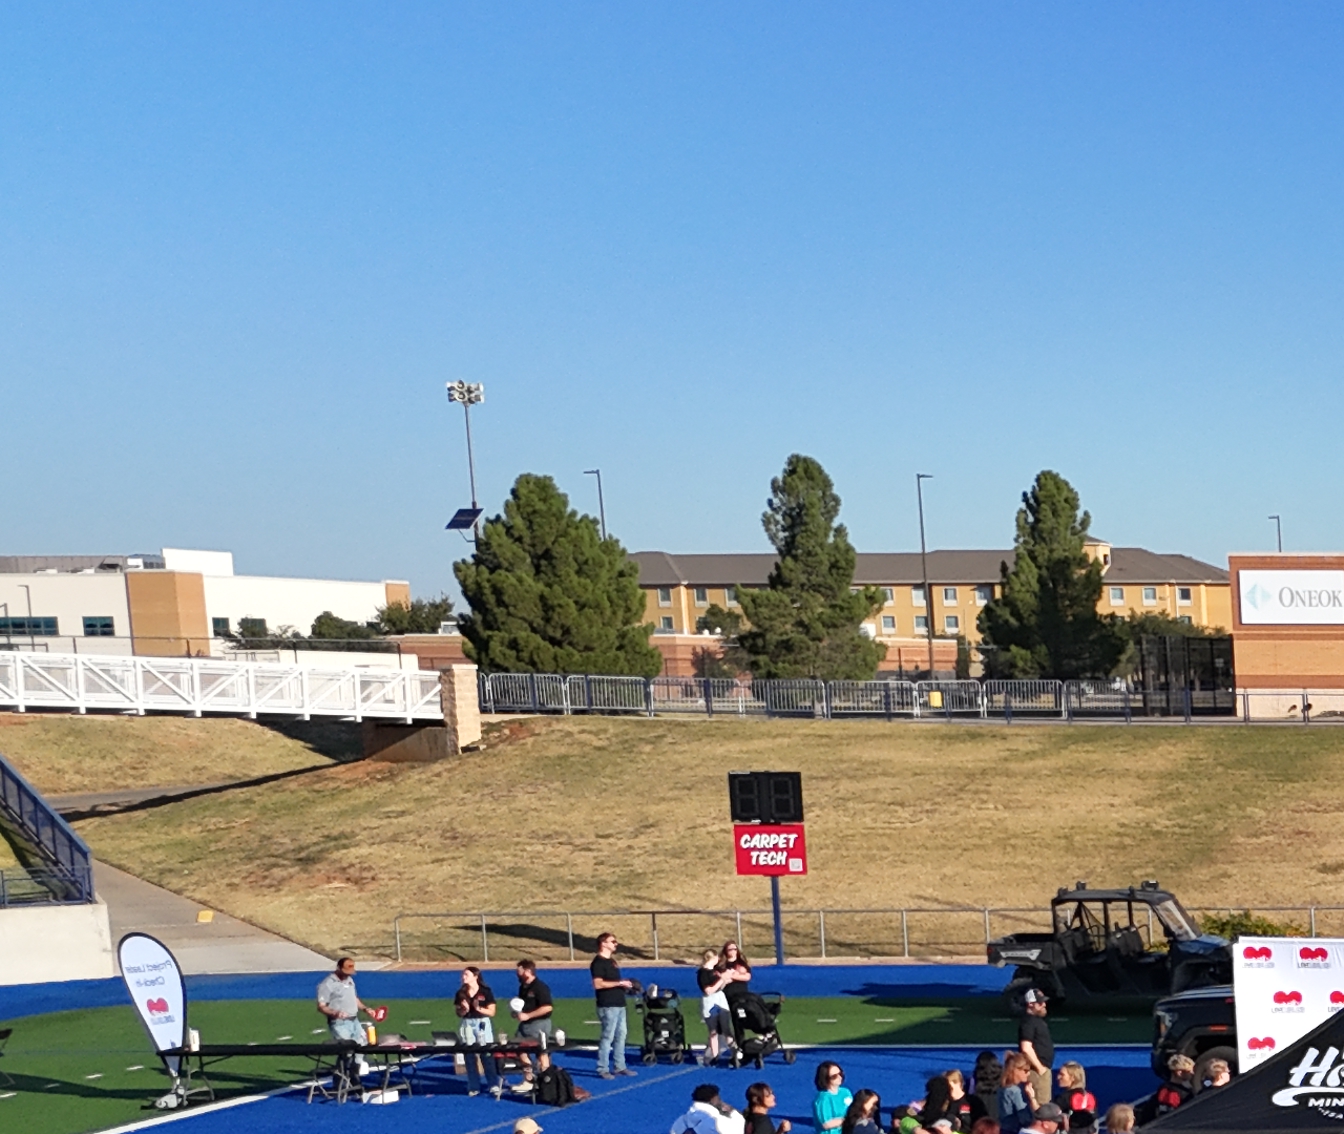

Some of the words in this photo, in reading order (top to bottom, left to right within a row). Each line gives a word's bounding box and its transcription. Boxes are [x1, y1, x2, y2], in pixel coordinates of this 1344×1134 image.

[1278, 586, 1343, 608] ONEOK
[740, 833, 798, 848] CARPET
[750, 851, 788, 865] TECH
